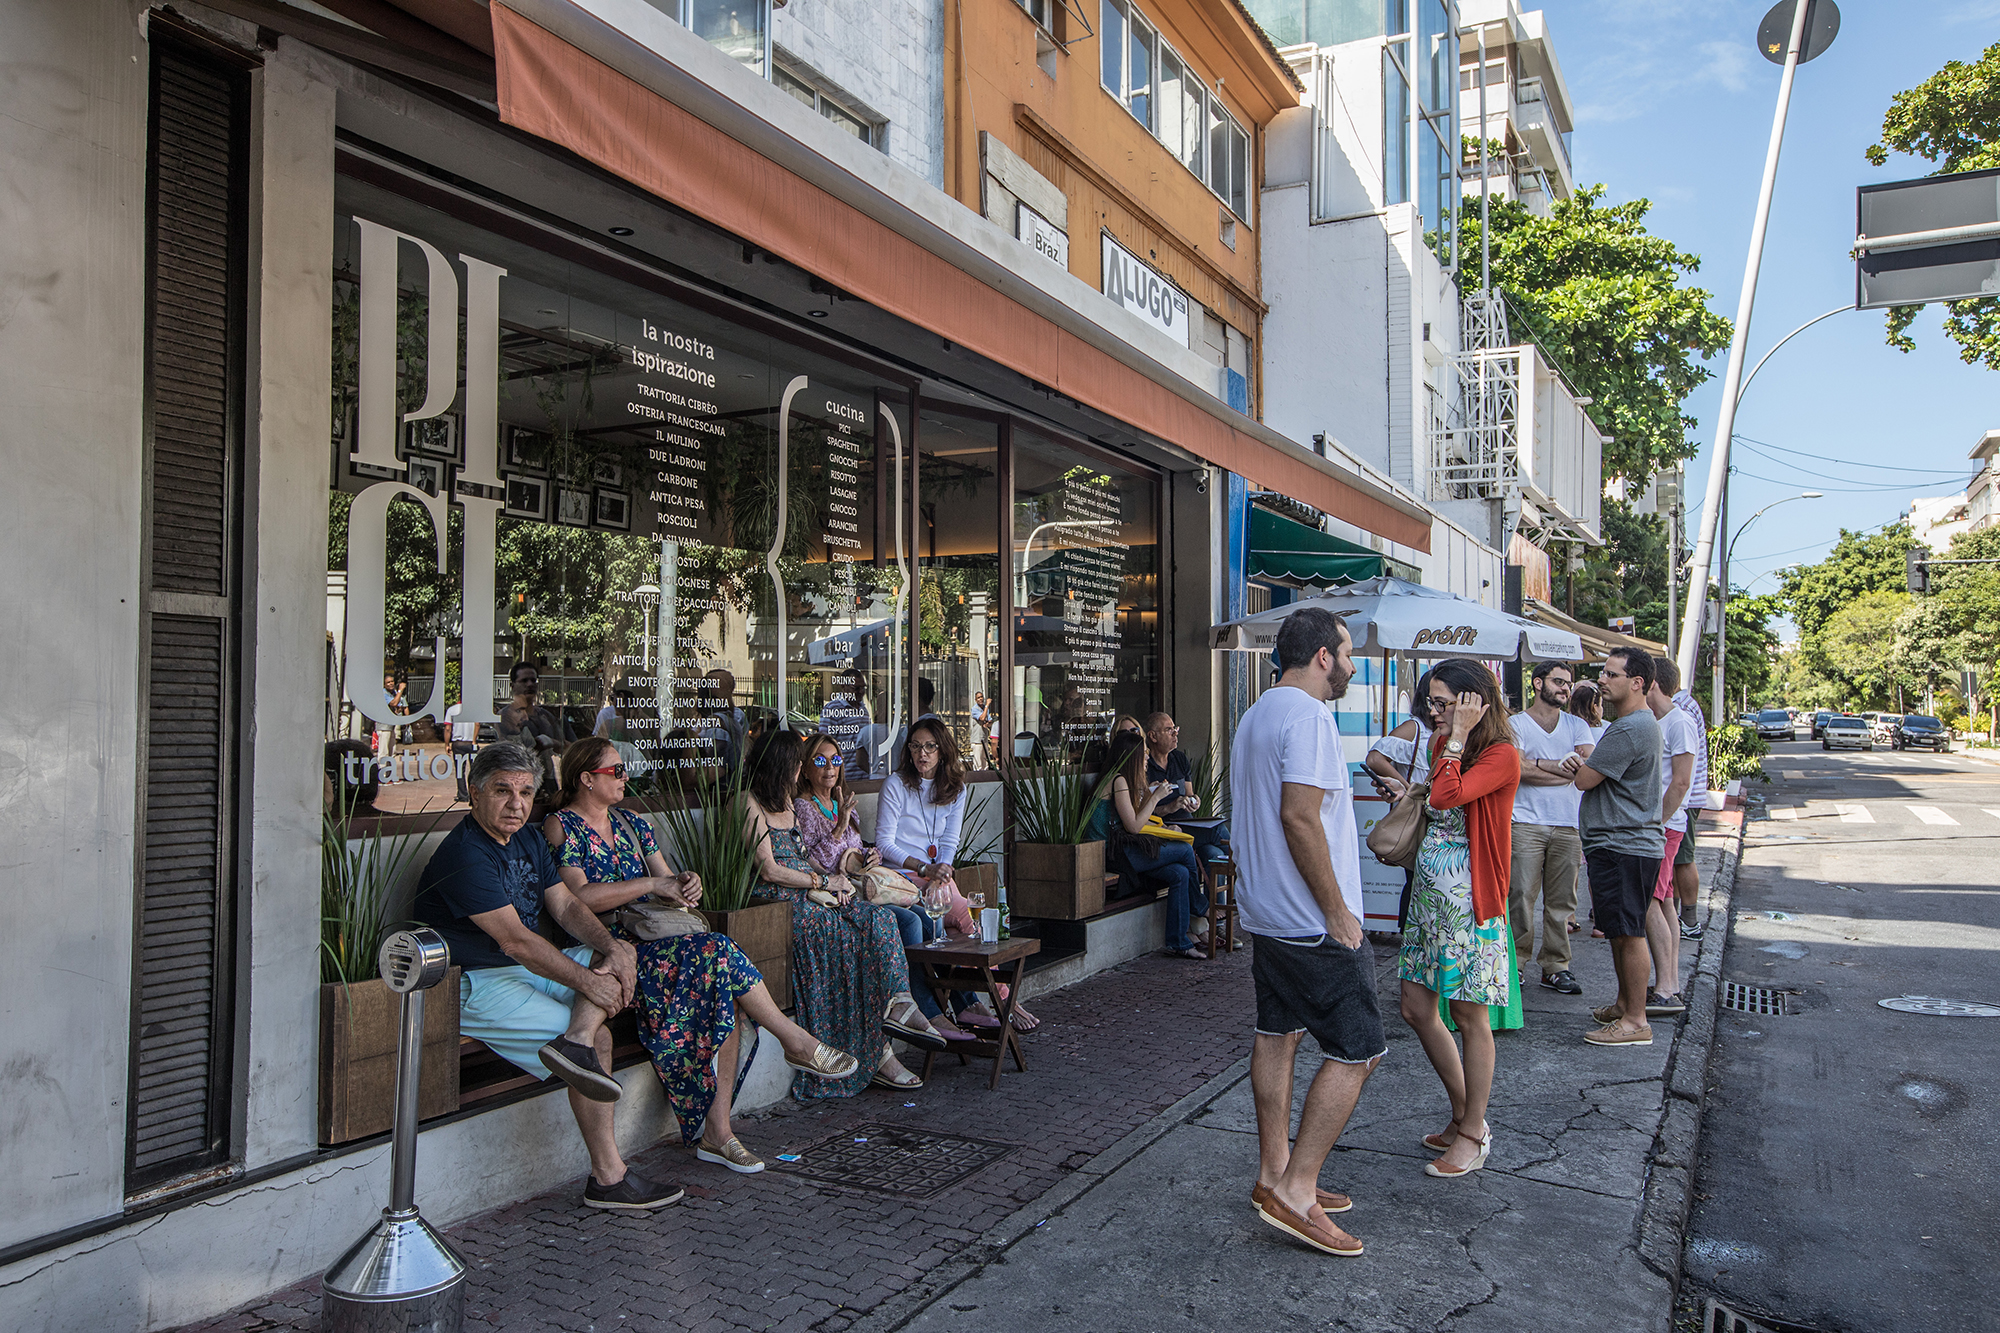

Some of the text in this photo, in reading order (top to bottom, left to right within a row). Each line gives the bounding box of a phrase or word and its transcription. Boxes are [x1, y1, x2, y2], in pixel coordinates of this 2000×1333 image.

[1035, 232, 1059, 263] Braz
[1106, 246, 1173, 327] ALUGO
[642, 318, 715, 360] la nostra
[632, 345, 716, 388] ispirazione
[637, 383, 686, 407] TRATTORIA
[826, 400, 865, 423] cucina
[627, 402, 726, 437] OSTERIA FRANCESCANA
[838, 423, 850, 435] PICI
[656, 430, 700, 450] IL MULINO
[826, 436, 860, 453] SPAGHETTI
[649, 449, 706, 471] DUE LADRONI
[829, 453, 858, 469] GNOCCHI
[657, 471, 698, 489] CARBONE
[830, 470, 856, 484] RISOTTO
[650, 491, 704, 510] ANTICA PESA
[830, 486, 857, 501] LASAGNE
[830, 502, 857, 516] GNOCCO
[657, 512, 698, 529] ROSCIOLI
[828, 519, 858, 533] ARANCINI
[652, 532, 702, 549] DA SILVANO
[822, 534, 861, 550] BRUSCHETTA
[653, 553, 700, 569] DEL POSTO
[832, 552, 854, 564] CRUDO
[641, 572, 710, 590] DAL BOLOGNESE
[834, 569, 853, 580] PESCE
[615, 590, 664, 605] TRATTORIA
[828, 602, 857, 613] CANNOLI
[635, 635, 674, 647] TAVERNA
[834, 637, 854, 653] bar
[1411, 626, 1478, 649] prófit
[612, 655, 733, 669] ANTICA OSTERIA VICO PALLA
[835, 660, 853, 669] VINO
[628, 676, 720, 688] ENOTECA PINCHIORRI
[831, 676, 856, 685] DRINKS
[616, 698, 625, 708] IL
[628, 698, 658, 708] LUOGO
[673, 698, 696, 708] AIMO
[698, 698, 702, 708] E
[704, 698, 729, 708] NADIA
[831, 692, 856, 701] GRAPPA
[822, 708, 864, 718] LIMONCELLO
[673, 718, 721, 728] MASCARETA
[827, 725, 860, 734] ESPRESSO
[634, 737, 714, 750] SORA MARGHERITA
[624, 760, 664, 771] ANTONIO
[667, 759, 677, 769] AL
